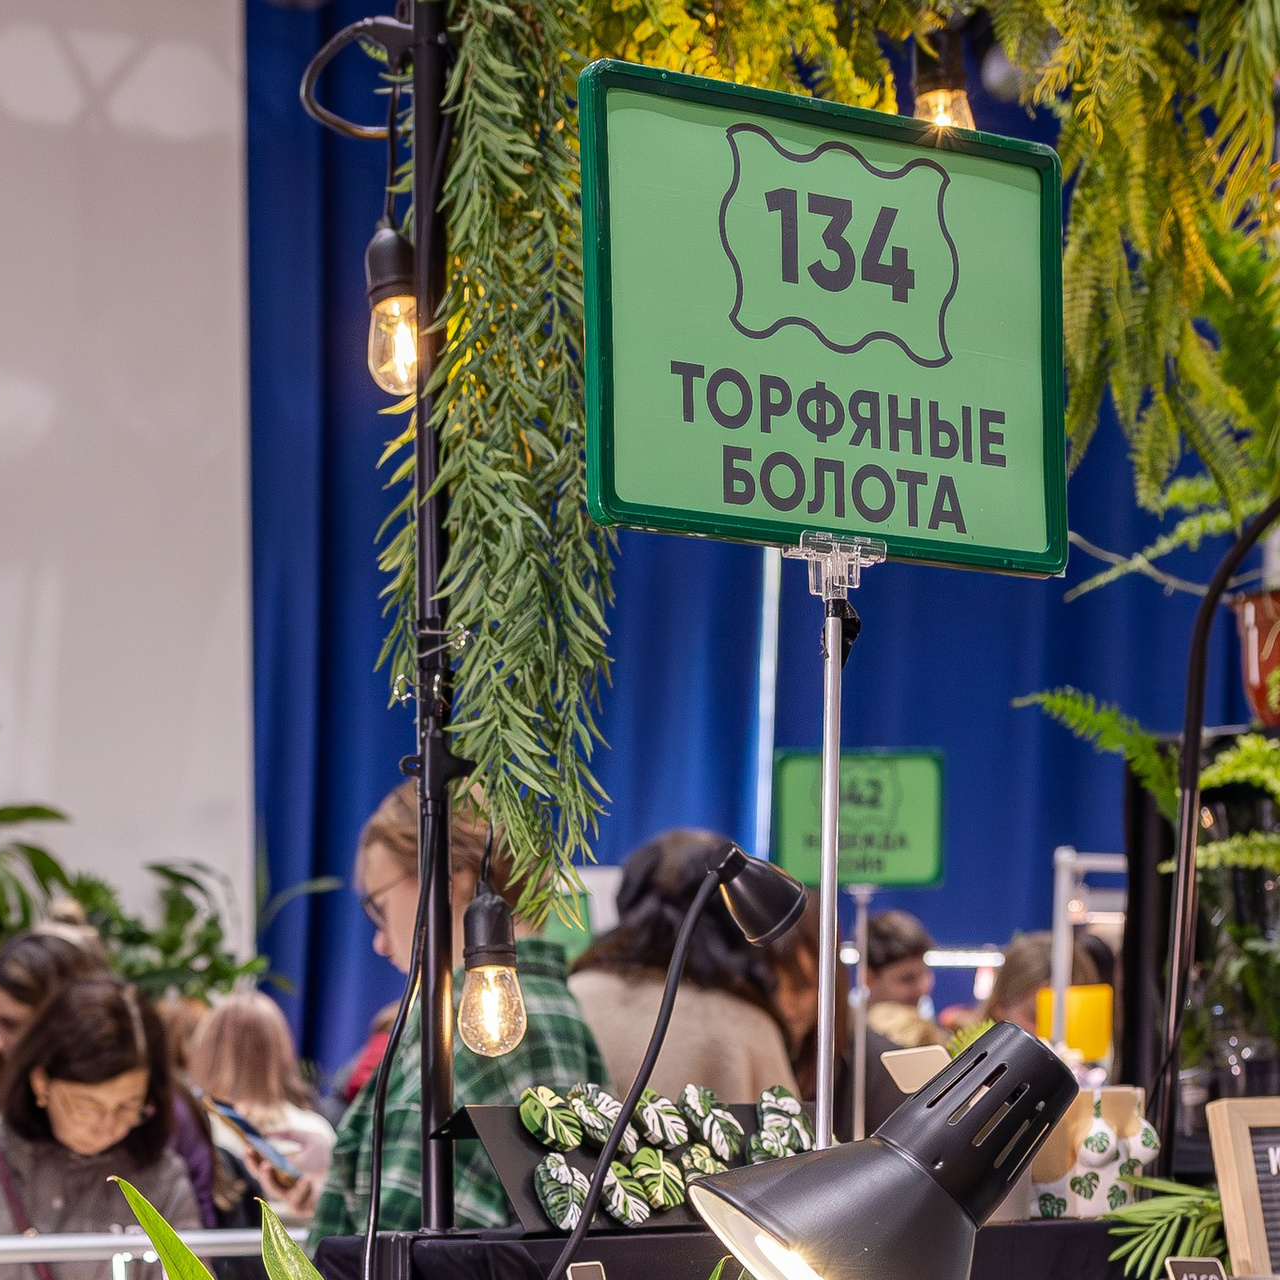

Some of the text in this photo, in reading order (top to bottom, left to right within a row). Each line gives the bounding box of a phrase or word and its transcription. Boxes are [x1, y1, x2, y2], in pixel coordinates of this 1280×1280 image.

[764, 187, 915, 303] 134
[670, 360, 1007, 468] ТОРФЯНЫЕ
[722, 444, 968, 535] БОЛОТА
